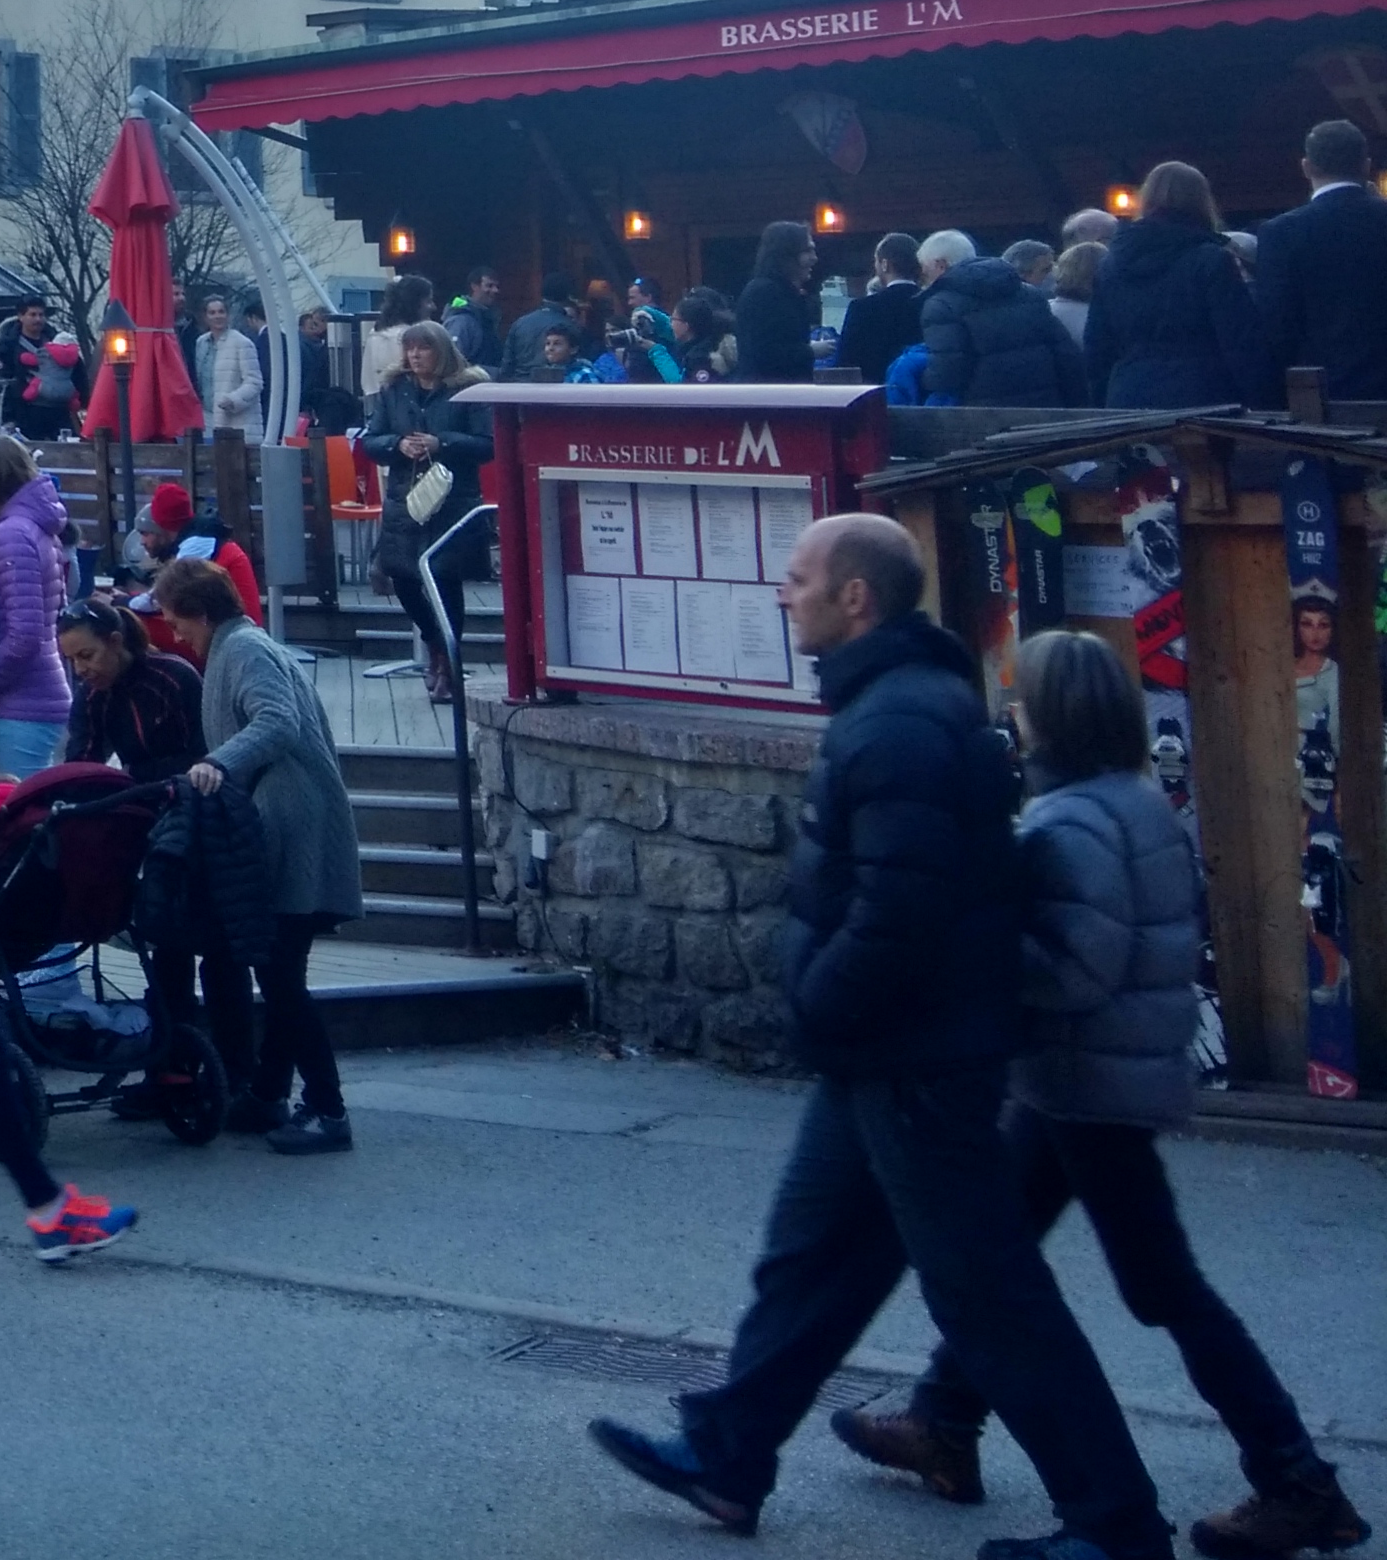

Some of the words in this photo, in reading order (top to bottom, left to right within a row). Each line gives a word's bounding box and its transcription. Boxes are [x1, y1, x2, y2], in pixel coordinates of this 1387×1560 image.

[721, 9, 879, 48] BRASSERIE
[568, 443, 676, 466] BRASSERIE
[683, 446, 711, 466] DE
[717, 421, 780, 468] L'M
[980, 504, 1003, 593] DYNASTR
[1296, 530, 1325, 547] ZAG
[1033, 549, 1048, 605] DYNASTAR
